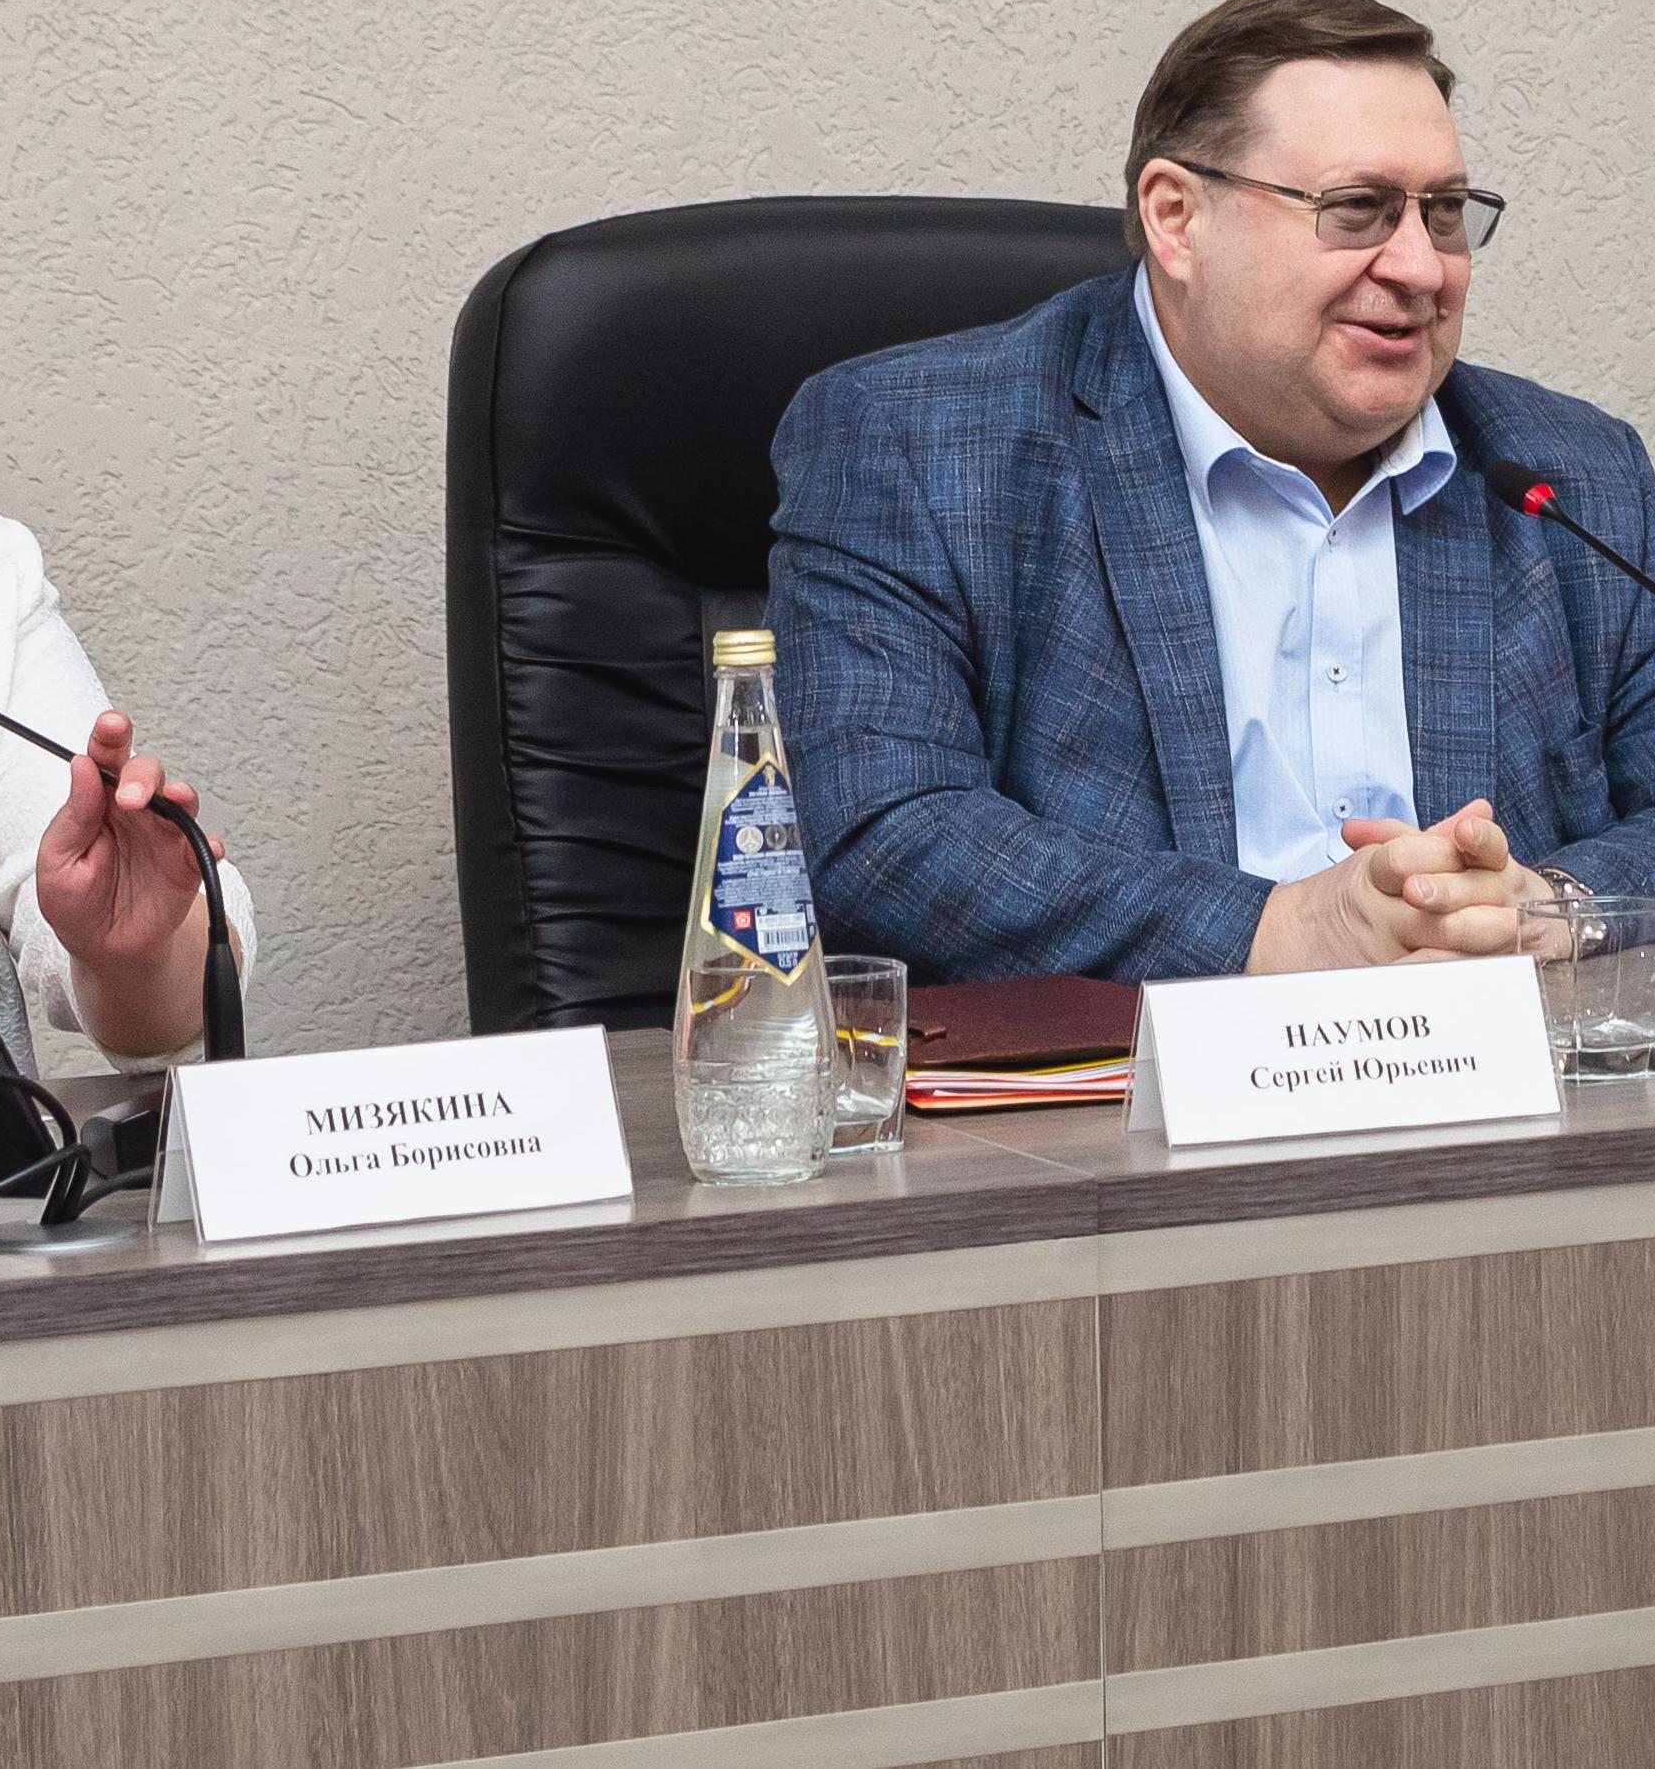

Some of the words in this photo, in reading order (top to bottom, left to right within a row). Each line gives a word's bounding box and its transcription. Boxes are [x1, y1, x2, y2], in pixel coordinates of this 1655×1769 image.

[1285, 1015, 1431, 1048] НАУМОВ
[1250, 1062, 1344, 1093] Сергей
[1353, 1056, 1477, 1085] Юрьевич
[305, 1091, 513, 1133] МИЗЯКИНА
[289, 1153, 381, 1177] Ольга
[390, 1136, 542, 1171] Борисовна
